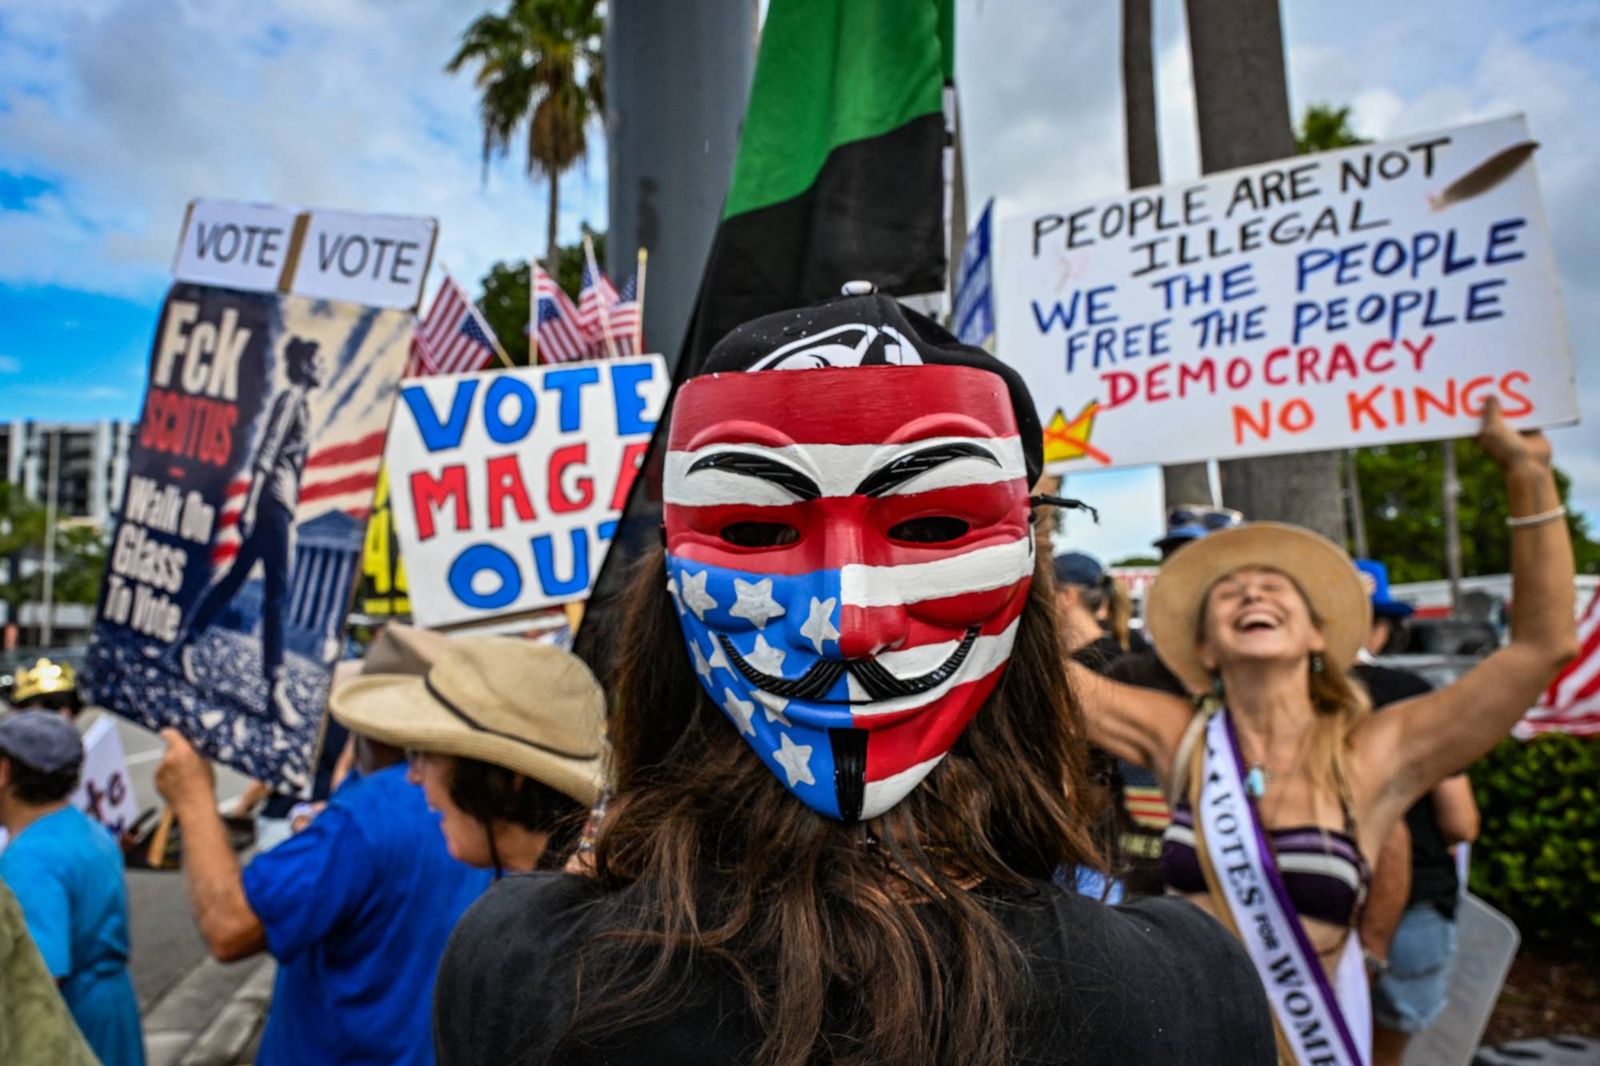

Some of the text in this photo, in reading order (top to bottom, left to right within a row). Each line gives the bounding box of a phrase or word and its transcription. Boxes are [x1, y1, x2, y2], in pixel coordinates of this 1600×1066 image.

[1031, 136, 1453, 258] PEOPLE ARE NOT
[196, 222, 285, 268] VOTE
[317, 232, 420, 285] VOTE
[1030, 217, 1527, 335] WE THE PEOPLE
[1130, 199, 1391, 278] ILLEGAL
[153, 300, 252, 401] Fck
[1065, 279, 1507, 373] FREE THE PEOPLE
[400, 363, 657, 453] VOTE
[1100, 334, 1435, 409] DEMOCRACY
[1232, 371, 1534, 446] NO KINGS
[140, 388, 239, 467] SCOTUS
[112, 522, 188, 594] Glass
[1208, 791, 1265, 908] VOTES
